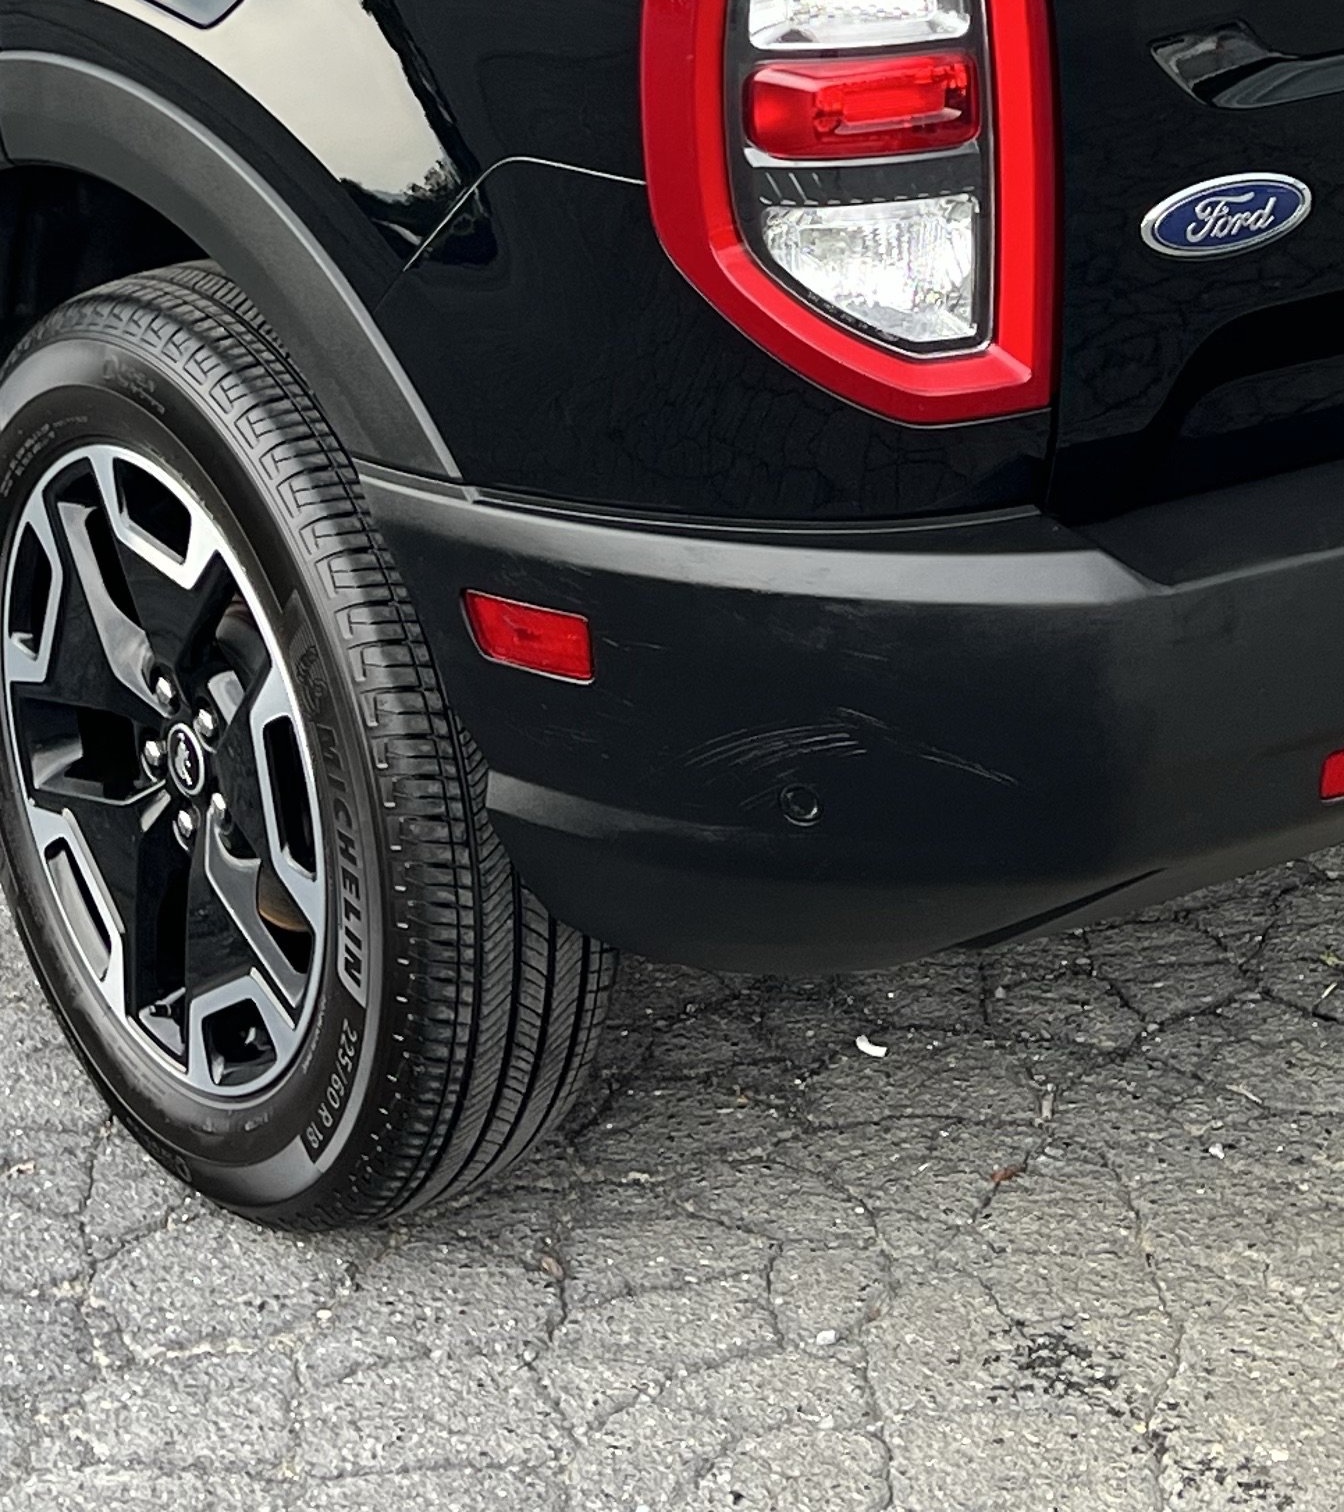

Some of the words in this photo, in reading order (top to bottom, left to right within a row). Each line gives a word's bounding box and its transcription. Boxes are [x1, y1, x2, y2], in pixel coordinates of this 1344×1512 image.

[1186, 191, 1277, 243] Ford
[316, 722, 363, 989] MICHELIN
[326, 1017, 358, 1110] 225/60
[306, 1121, 324, 1149] 18
[317, 1102, 334, 1128] R
